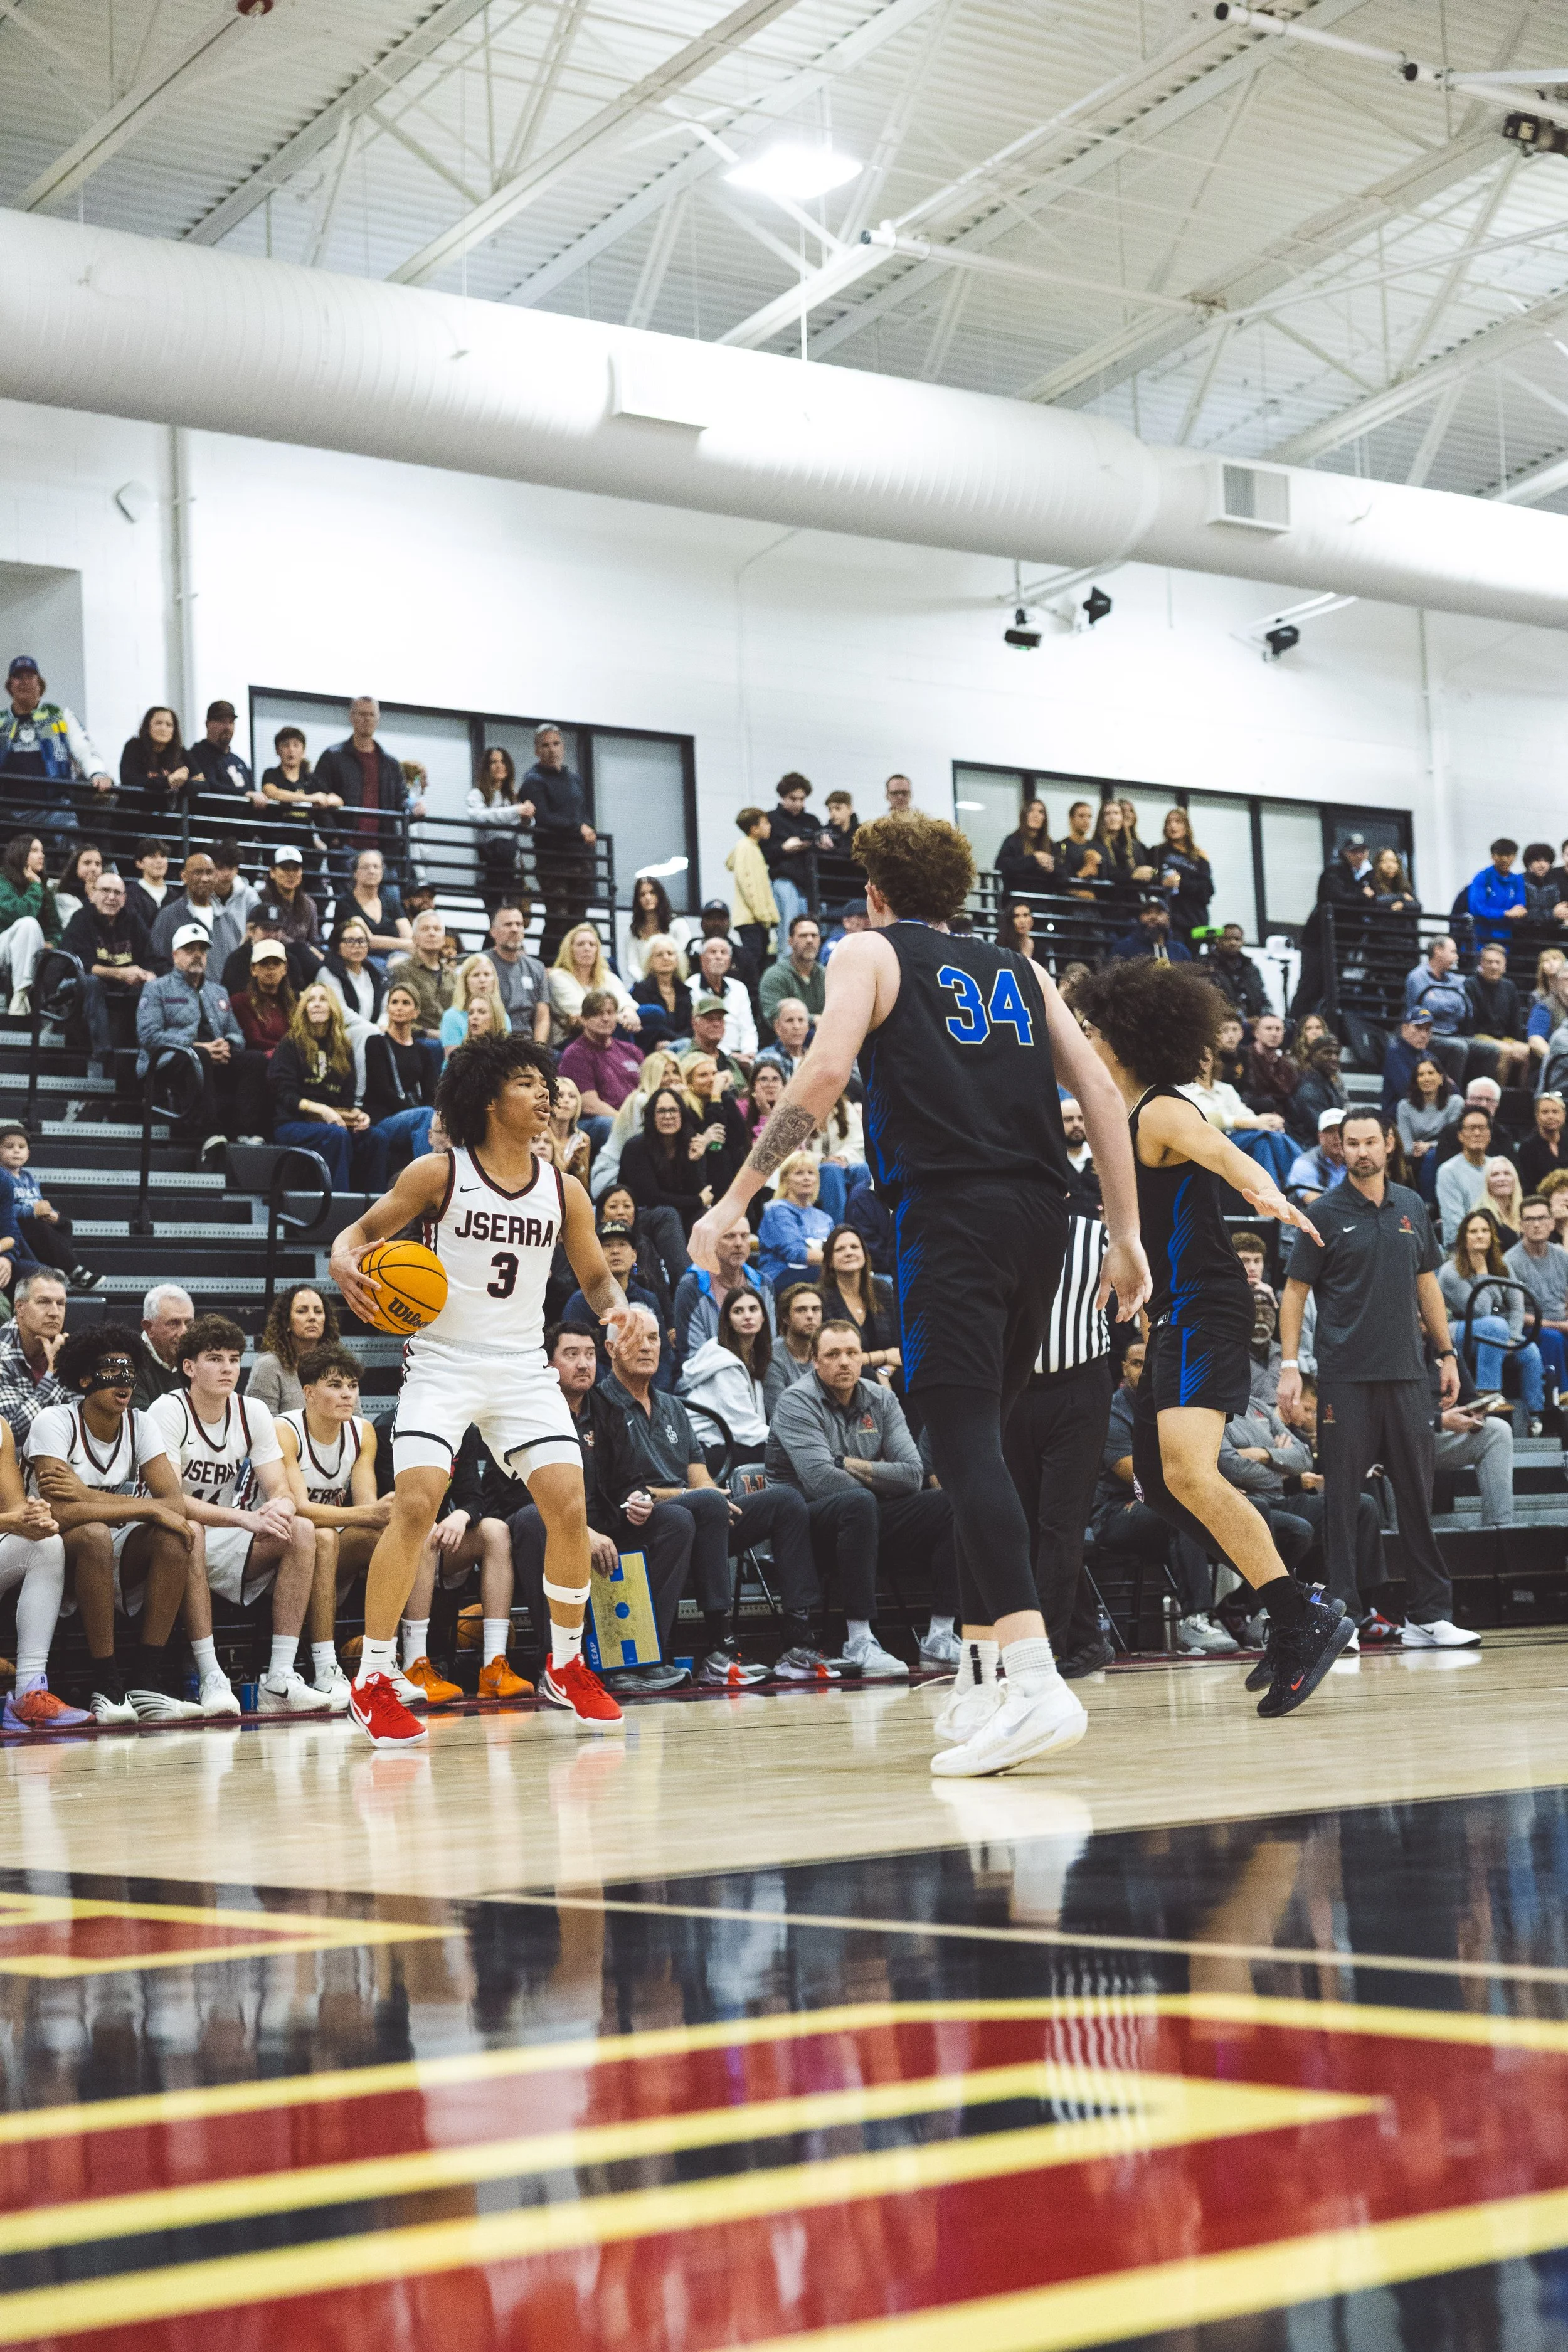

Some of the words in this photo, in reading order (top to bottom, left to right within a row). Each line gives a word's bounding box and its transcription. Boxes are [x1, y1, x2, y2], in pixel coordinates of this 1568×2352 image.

[936, 964, 1034, 1046] 34
[454, 1210, 554, 1248] JSERRA
[487, 1251, 519, 1300] 3
[388, 1296, 433, 1328] Wilso
[590, 1641, 600, 1665] LEAP
